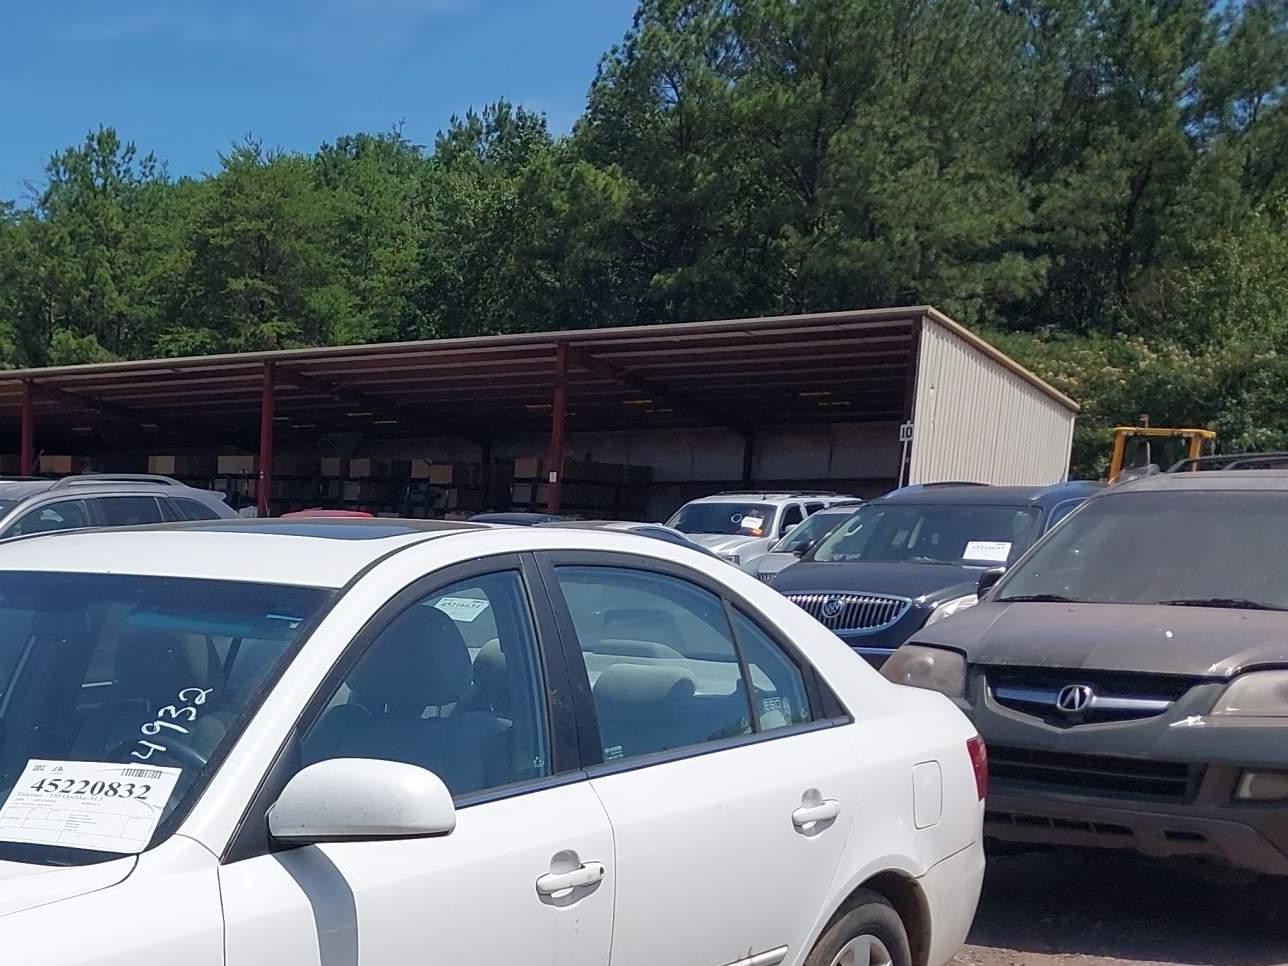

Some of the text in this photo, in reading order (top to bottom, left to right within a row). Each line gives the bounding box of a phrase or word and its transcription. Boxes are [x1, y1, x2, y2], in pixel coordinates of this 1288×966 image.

[902, 426, 912, 438] 10
[130, 687, 213, 760] 4932
[30, 777, 152, 800] 45220832
